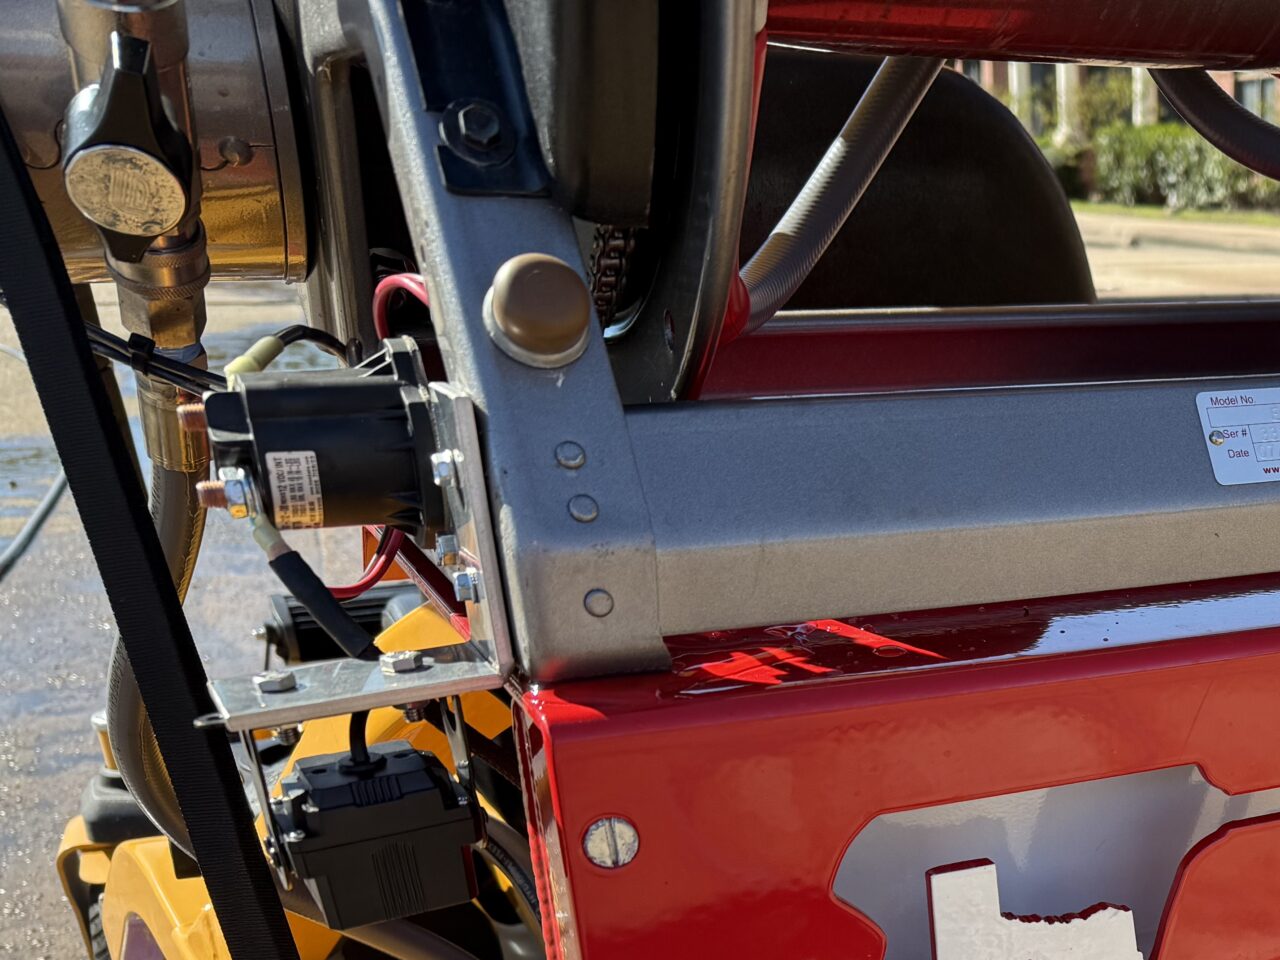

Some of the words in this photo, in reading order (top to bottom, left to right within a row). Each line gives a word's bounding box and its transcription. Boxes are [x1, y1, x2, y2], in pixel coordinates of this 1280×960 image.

[1210, 395, 1239, 406] Model
[1222, 429, 1239, 439] Ser
[1241, 428, 1248, 437] #
[1227, 449, 1250, 459] Date
